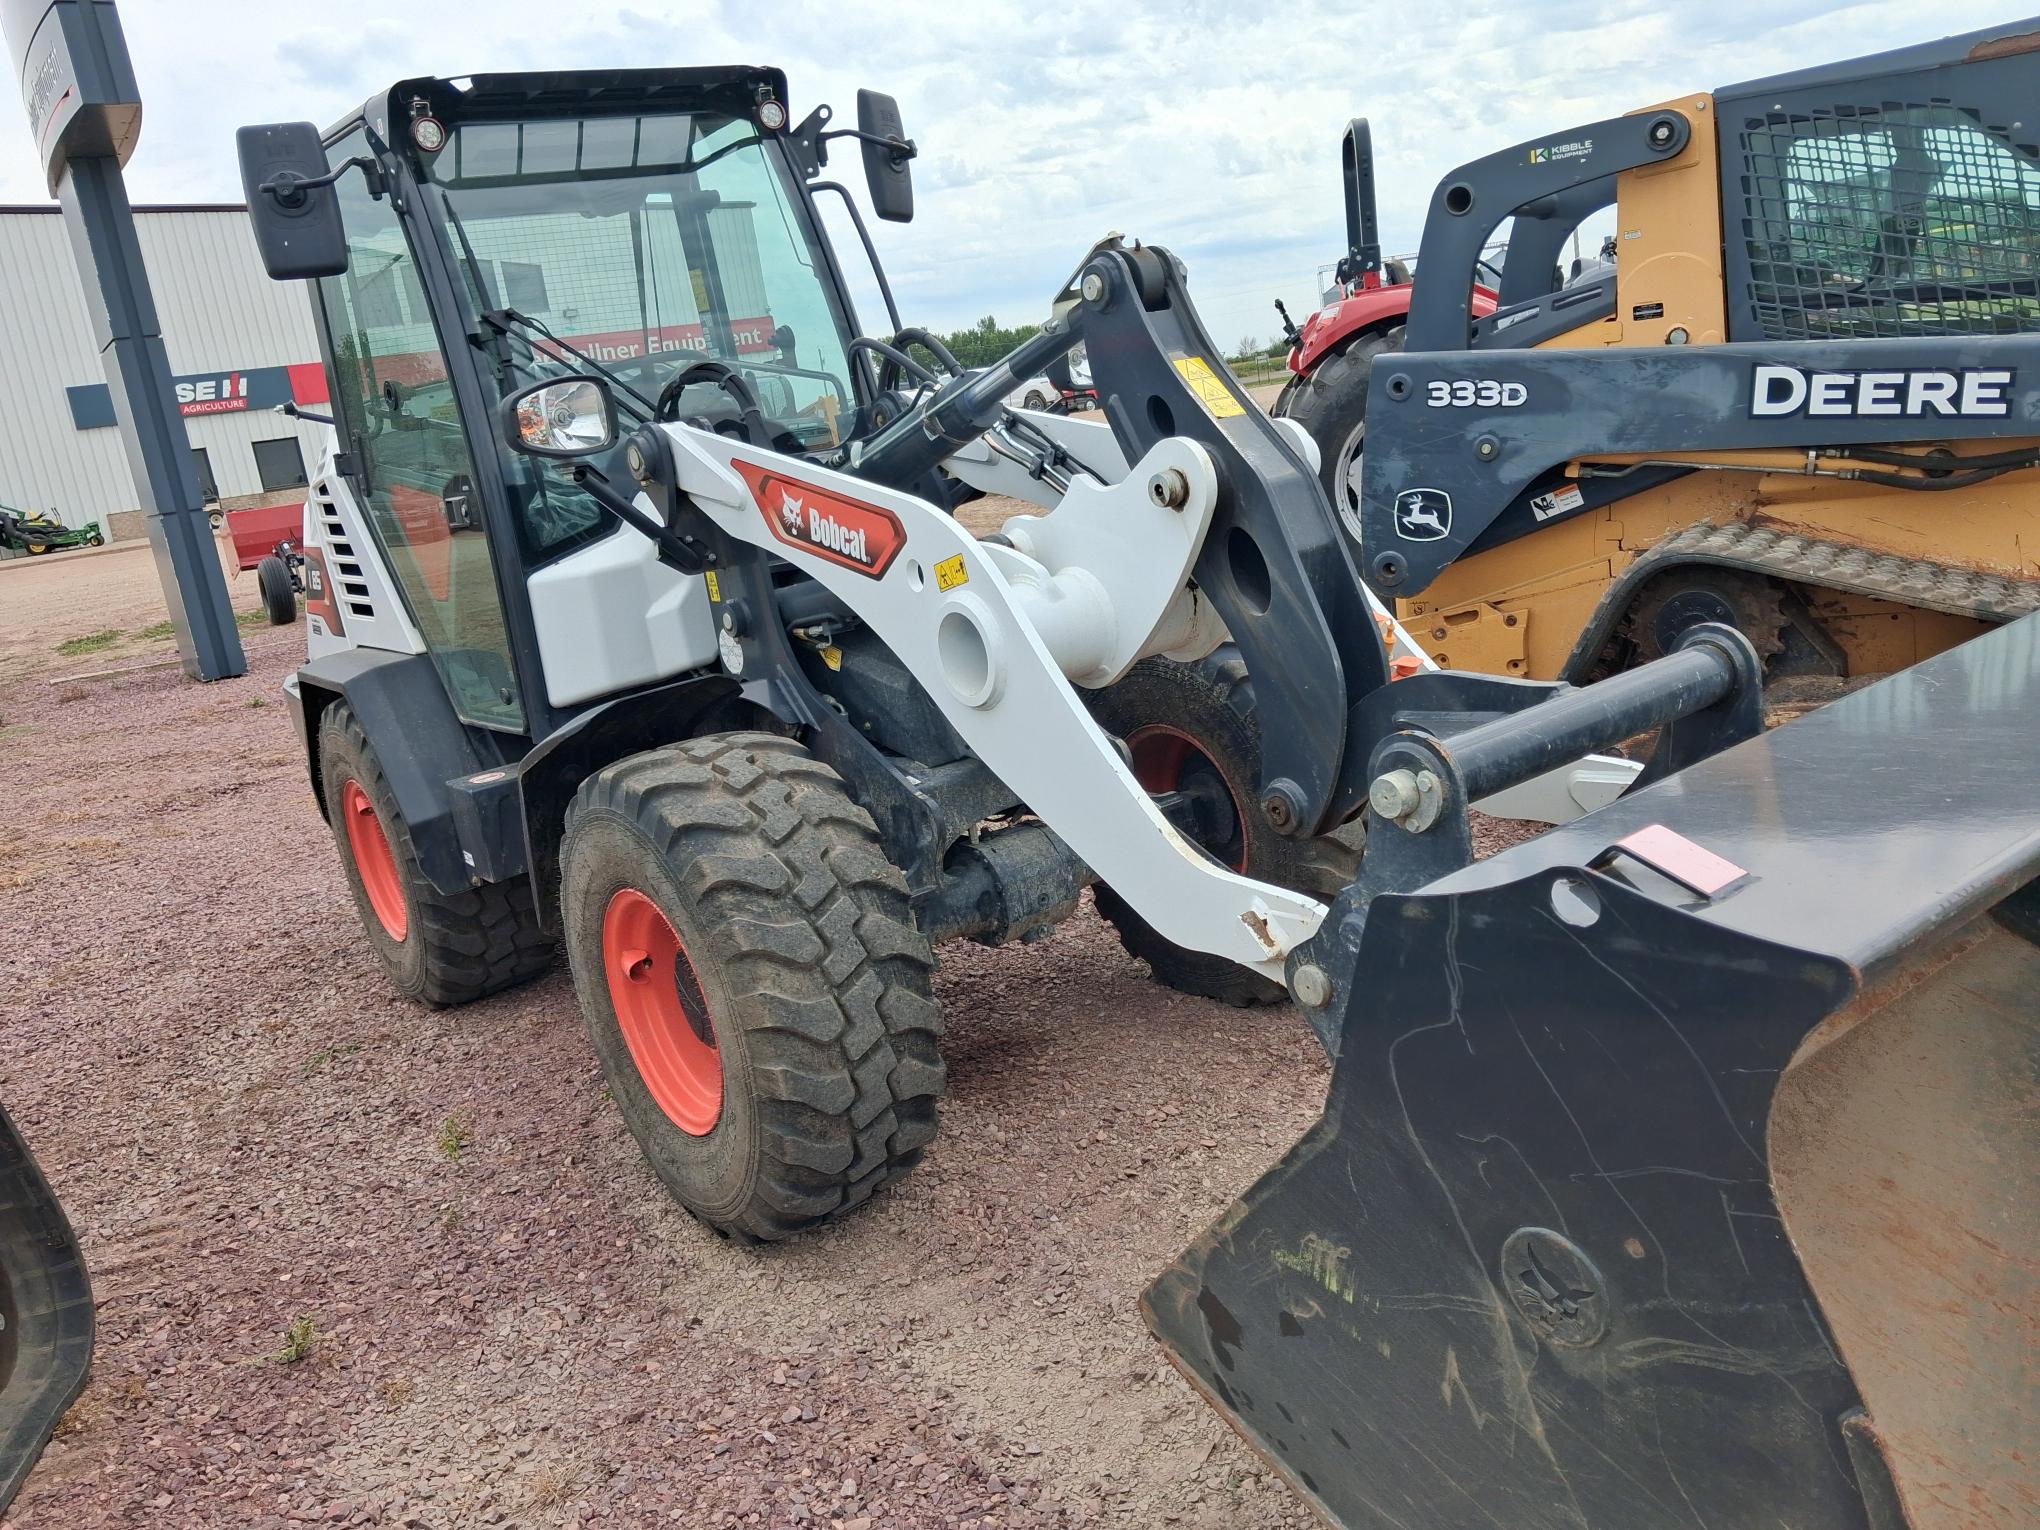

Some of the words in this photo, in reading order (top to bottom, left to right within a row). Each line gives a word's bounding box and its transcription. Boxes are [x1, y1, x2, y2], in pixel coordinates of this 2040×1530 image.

[1551, 139, 1593, 155] KIBBLE
[1551, 148, 1593, 160] EQUIPMENT
[648, 327, 763, 355] Equipent
[175, 380, 216, 403] SE
[1427, 379, 1528, 407] 333D
[1752, 366, 2011, 415] DEERE
[183, 399, 245, 414] AGRICULTURE
[808, 507, 868, 564] Bobcat
